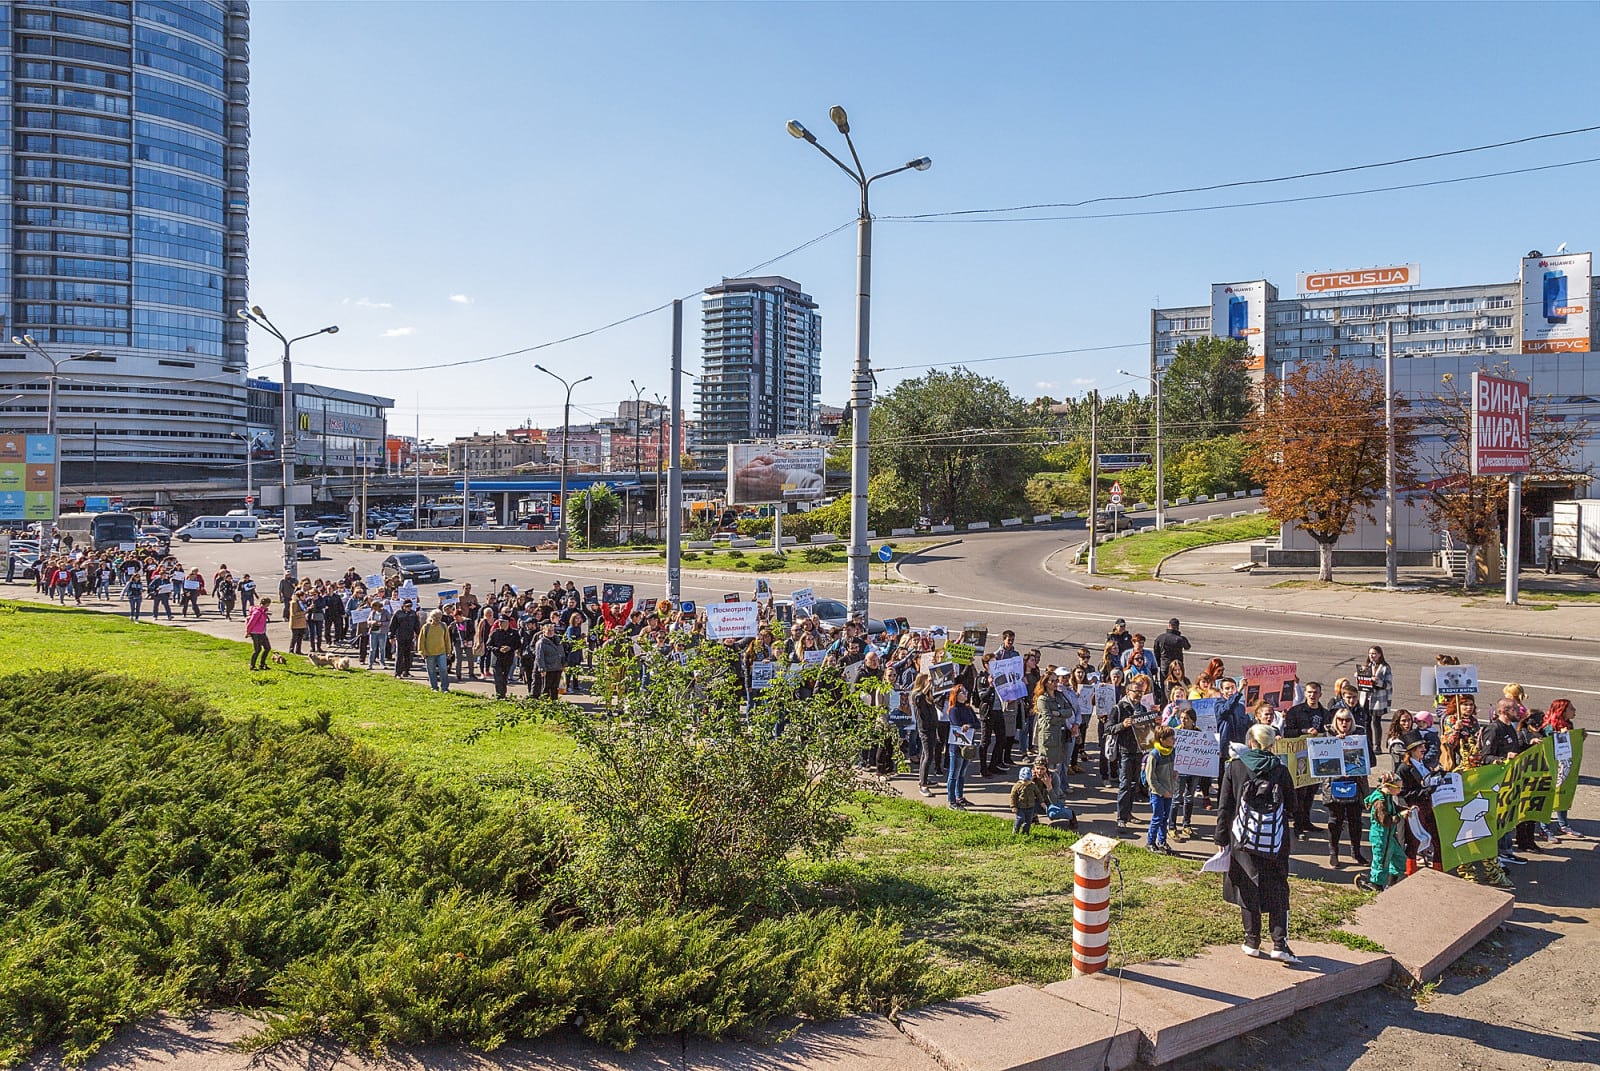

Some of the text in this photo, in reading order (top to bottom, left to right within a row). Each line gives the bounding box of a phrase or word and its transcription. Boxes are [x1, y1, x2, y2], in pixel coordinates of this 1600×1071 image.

[1310, 270, 1405, 288] CITRUS.UA
[1527, 340, 1584, 351] ЦИТРУС
[1479, 380, 1521, 415] ВИНА
[713, 606, 753, 614] Посмотрите
